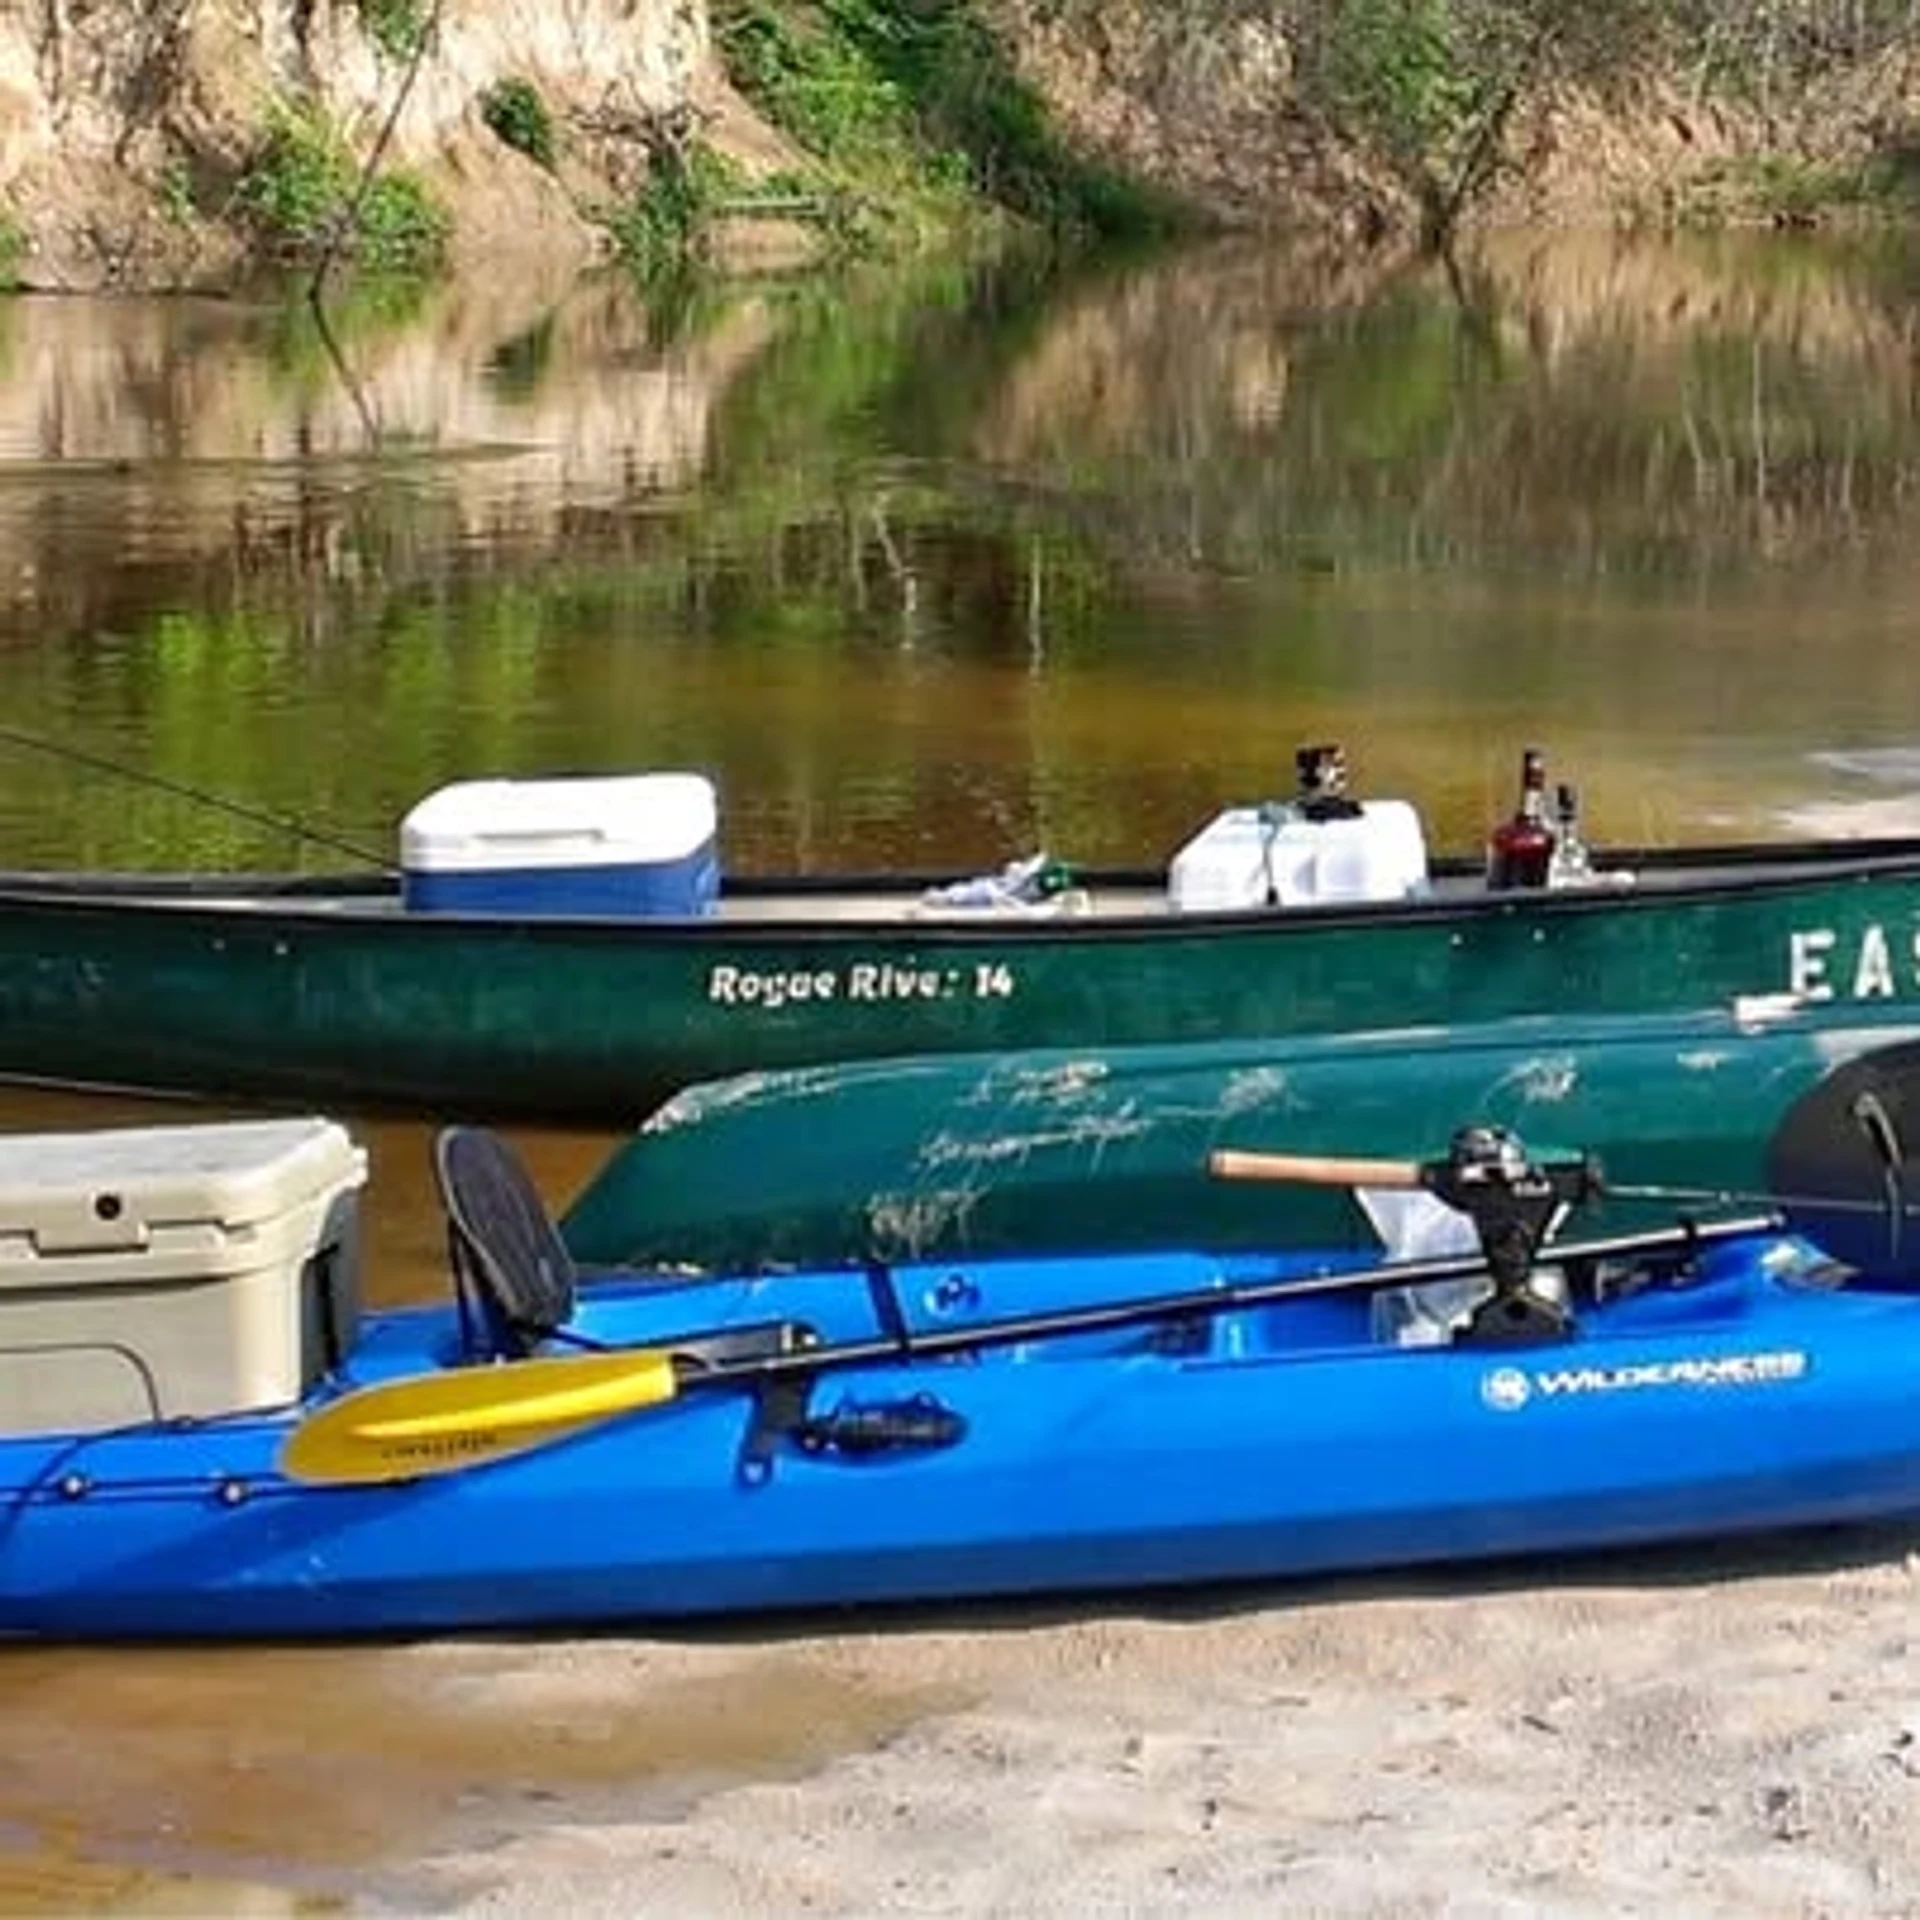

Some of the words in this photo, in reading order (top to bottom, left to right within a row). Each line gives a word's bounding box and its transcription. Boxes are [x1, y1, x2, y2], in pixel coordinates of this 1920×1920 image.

[975, 963, 1013, 998] 14
[1790, 924, 1920, 1001] EA
[1536, 1351, 1807, 1395] WILDERNE
